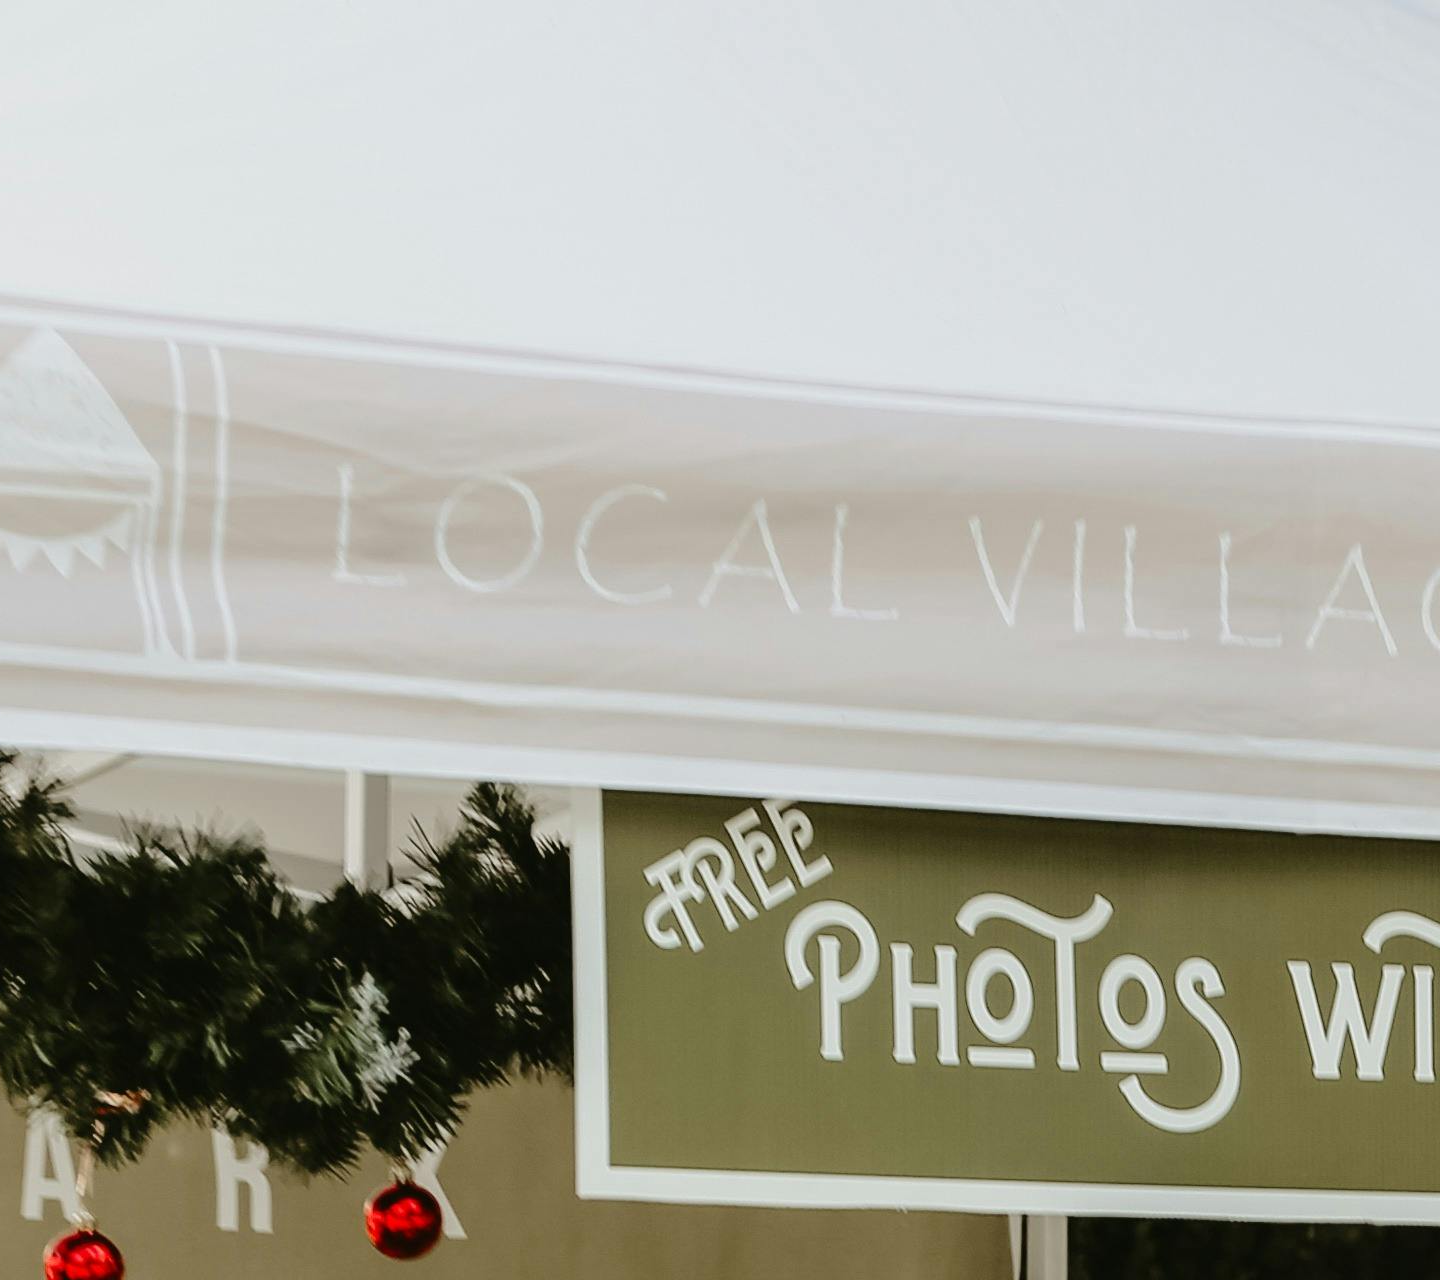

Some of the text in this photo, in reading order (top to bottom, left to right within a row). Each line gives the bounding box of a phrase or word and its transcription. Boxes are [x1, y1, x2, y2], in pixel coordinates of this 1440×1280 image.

[333, 462, 899, 622] LOCAL
[642, 799, 835, 954] FREE
[783, 892, 1243, 1134] PHOTOS
